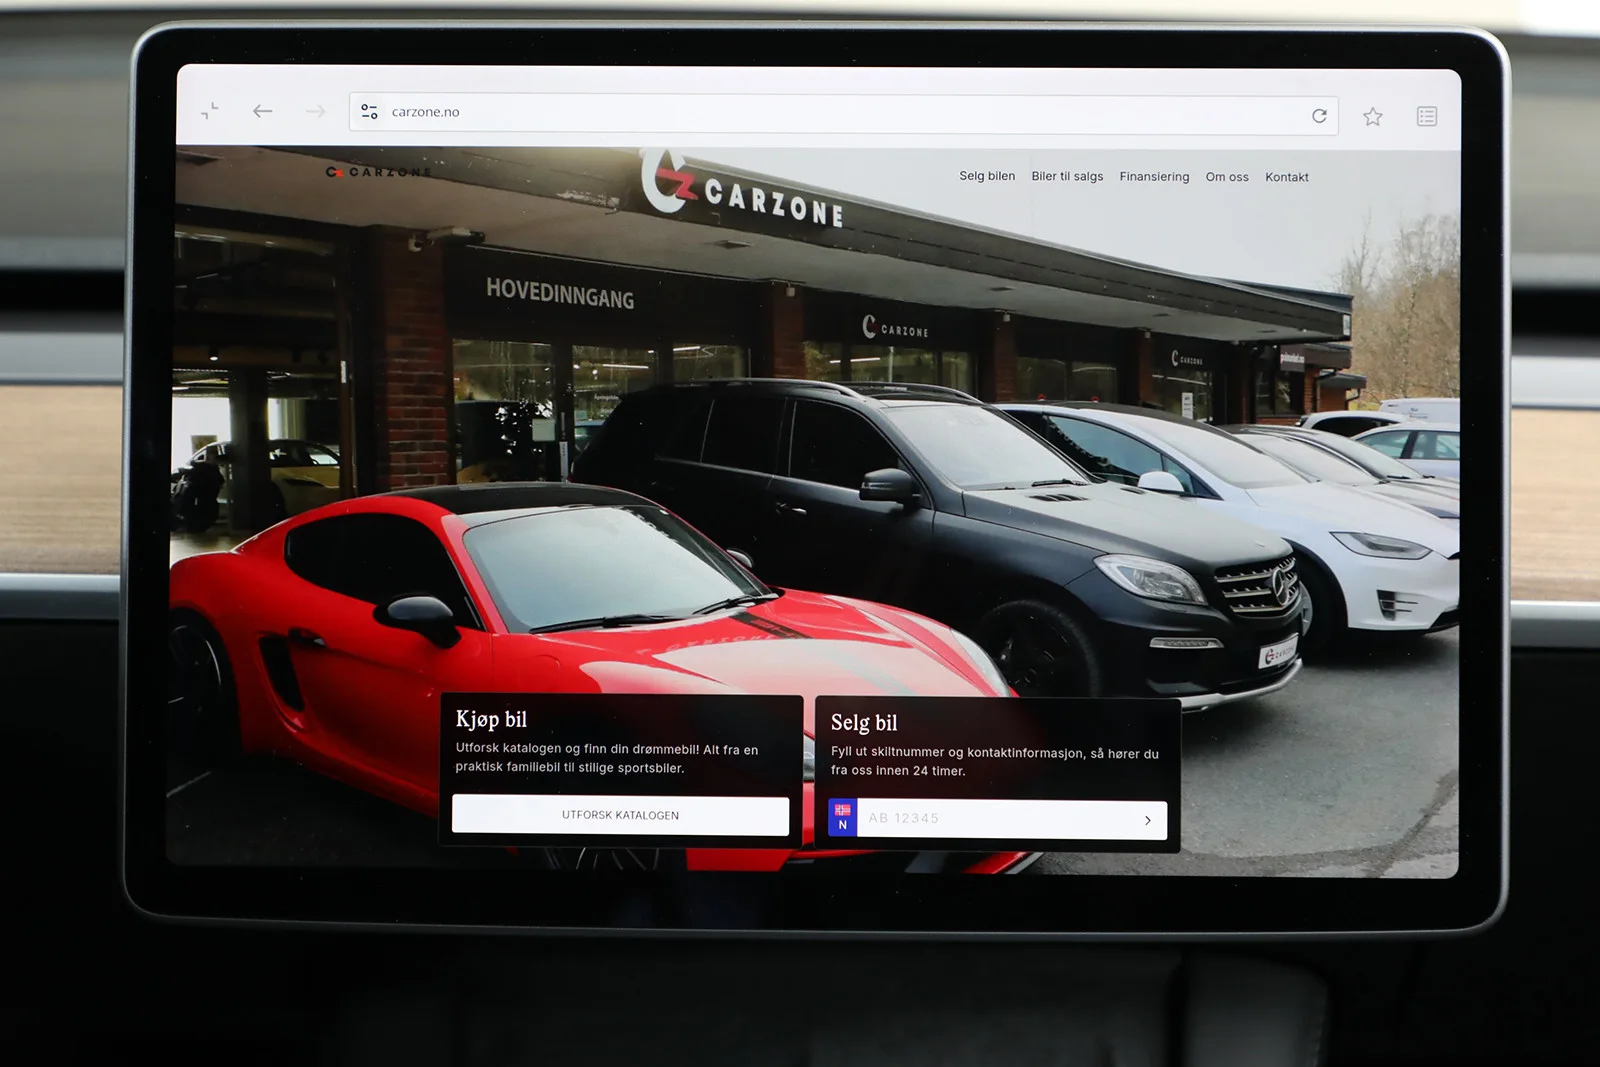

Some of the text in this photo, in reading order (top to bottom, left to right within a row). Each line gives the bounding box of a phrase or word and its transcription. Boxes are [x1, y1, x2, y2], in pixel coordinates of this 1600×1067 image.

[391, 107, 460, 118] carzone.no
[349, 167, 432, 177] CARZONE
[959, 170, 1016, 184] Selg bilen
[1031, 170, 1104, 185] Biler til salgs
[1119, 170, 1190, 185] Finansiering
[1205, 171, 1250, 182] Om oss
[1265, 171, 1310, 183] Kontakt
[705, 178, 843, 228] CARZONE
[486, 276, 635, 310] HOVEDINNGANG
[881, 324, 928, 338] CARZONE
[455, 709, 528, 732] Kjøp bil
[831, 713, 898, 736] Selg bil
[456, 742, 759, 757] Utforsk katalogen og finn din drømmebil! Alt fra en
[831, 745, 1160, 762] Fyll ut skiltnummer og kontaktinformasjon, så hører du
[455, 761, 685, 777] praktisk familiebil til stilige sportsbiler.
[830, 764, 967, 777] fra oss innen 24 timer.
[562, 809, 680, 821] UTFORSK KATALOGEN
[868, 812, 940, 824] AB 12345
[838, 819, 848, 830] N
